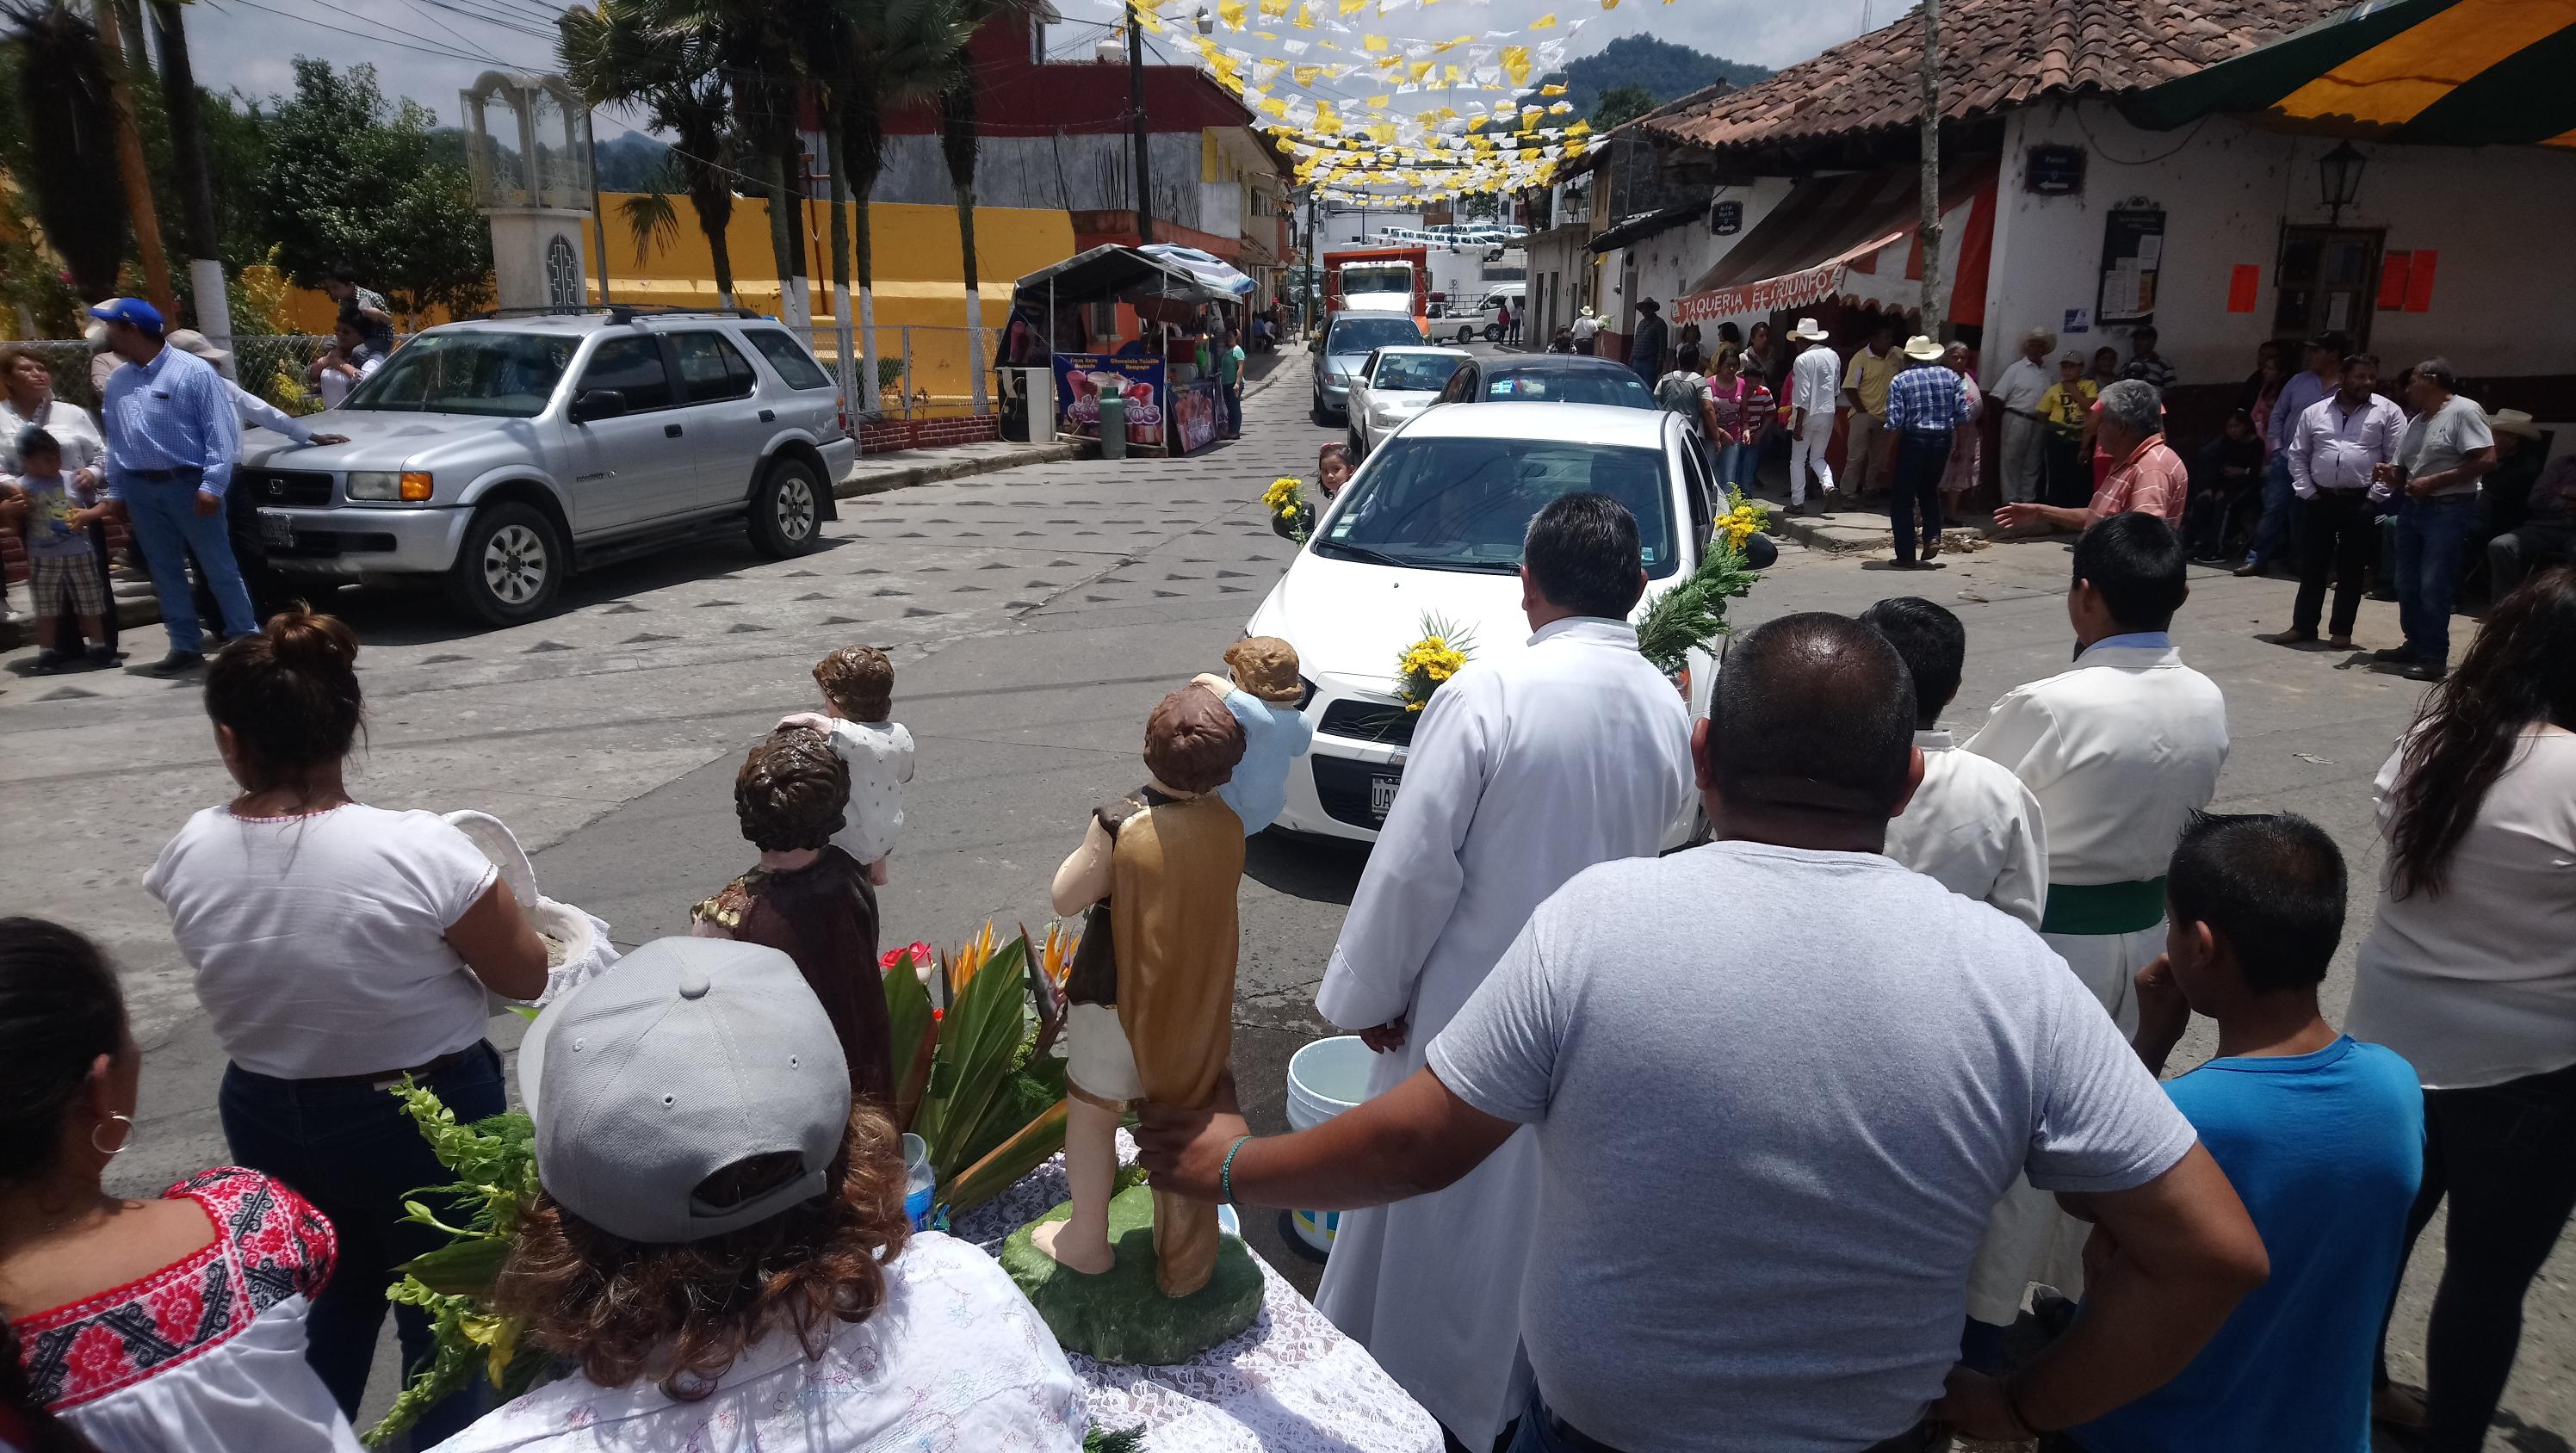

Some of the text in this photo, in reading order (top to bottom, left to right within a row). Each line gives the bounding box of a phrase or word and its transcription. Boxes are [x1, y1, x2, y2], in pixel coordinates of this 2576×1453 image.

[1683, 292, 1743, 316] TAQUERIA
[1752, 288, 1769, 303] EL
[1770, 272, 1828, 299] TRIUNFO
